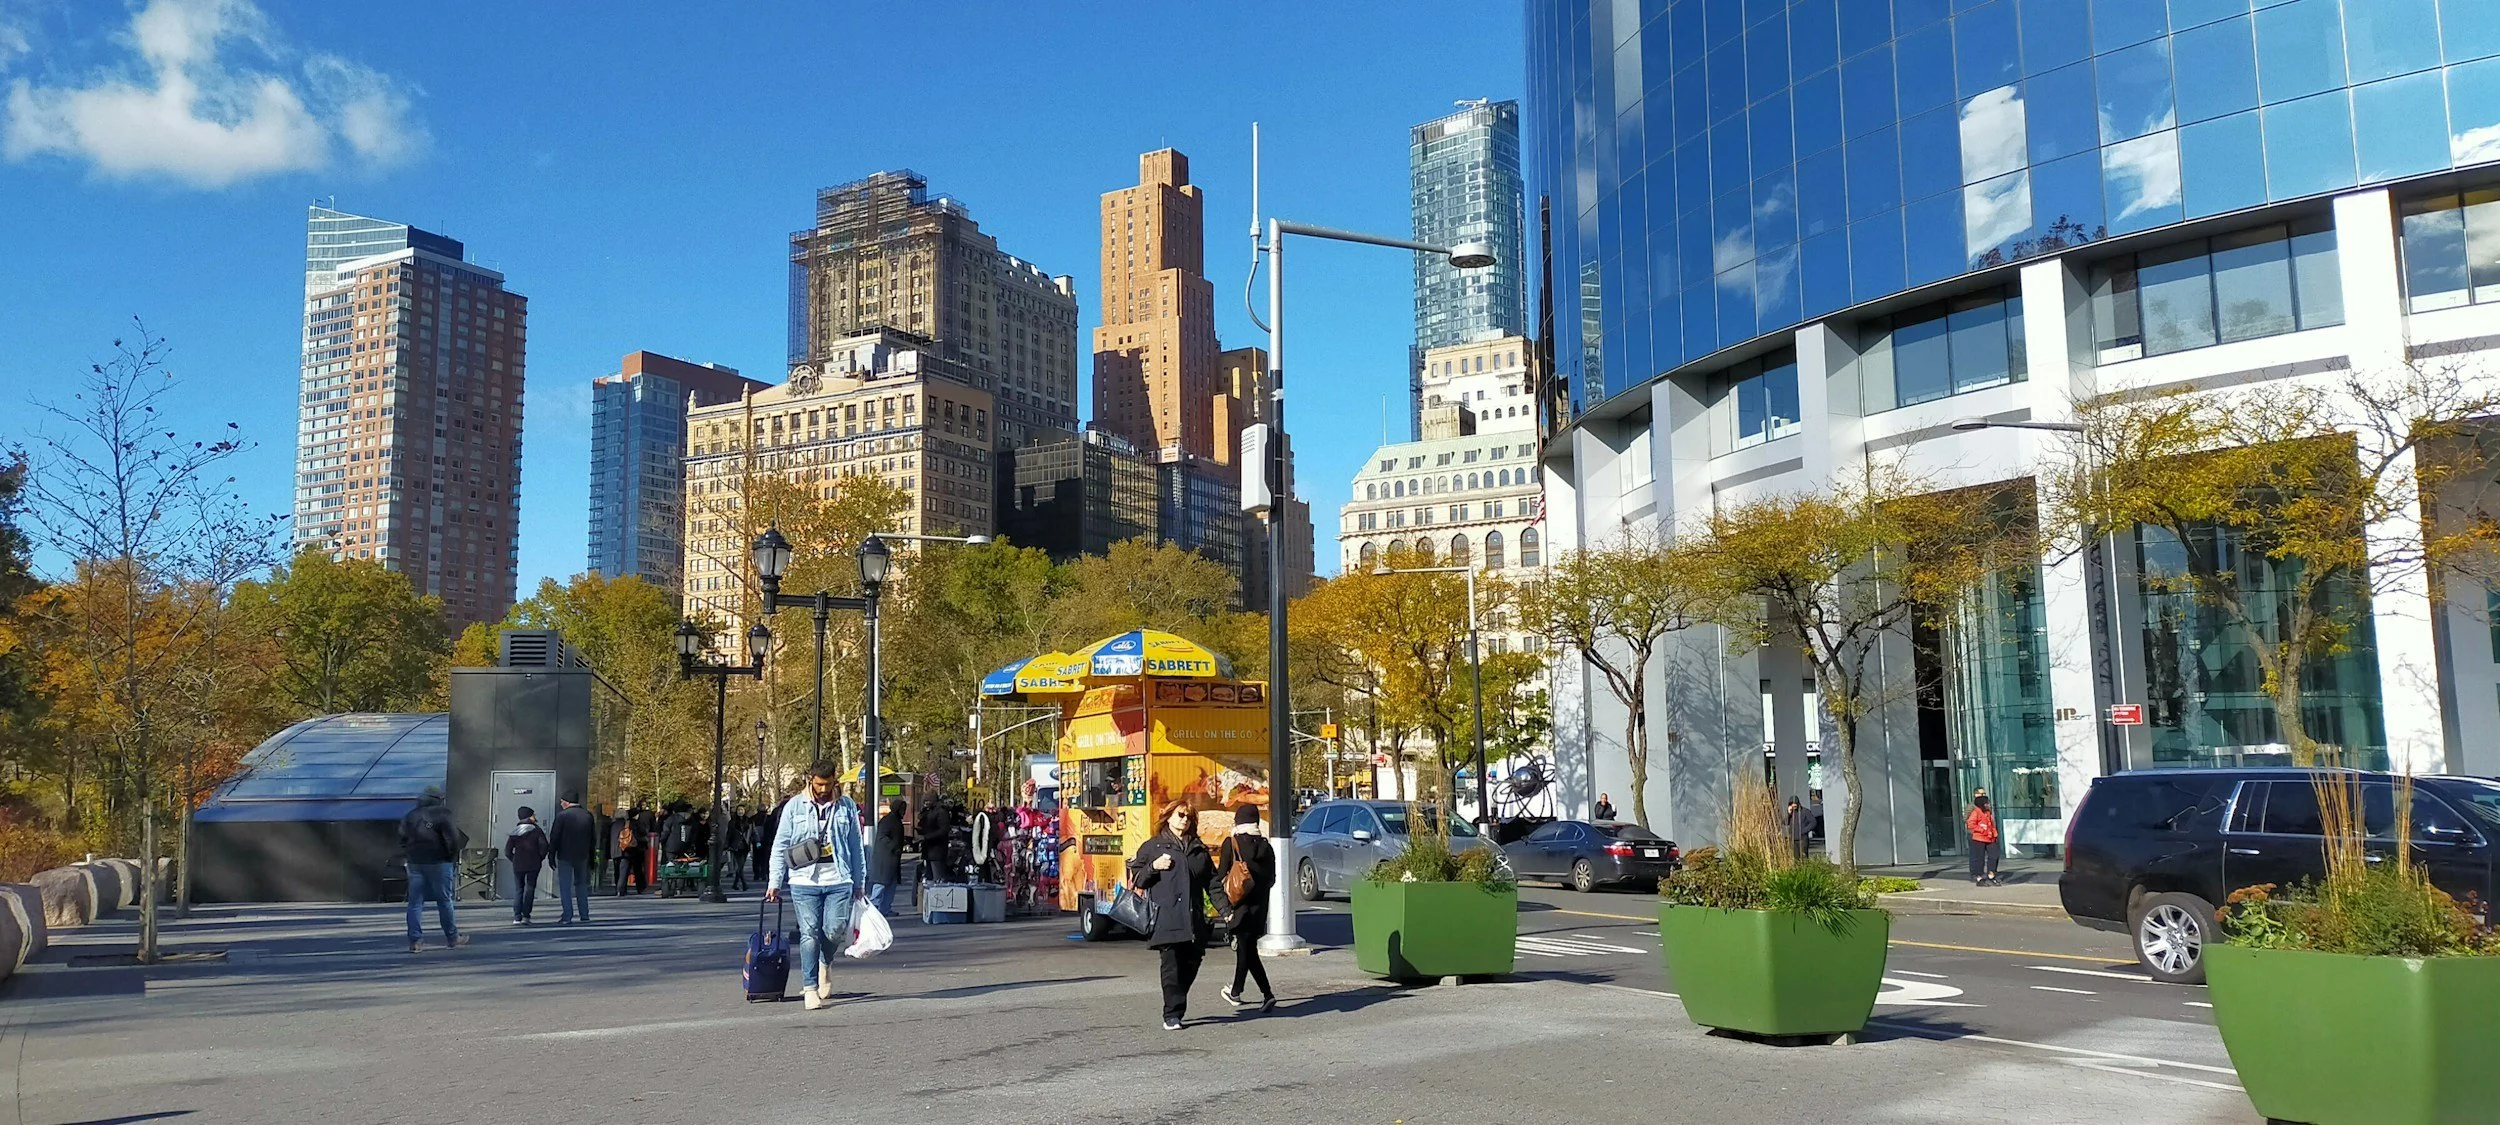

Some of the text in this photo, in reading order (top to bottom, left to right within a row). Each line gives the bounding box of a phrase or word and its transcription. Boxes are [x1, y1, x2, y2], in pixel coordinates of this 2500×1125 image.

[1148, 659, 1210, 672] SABRETT
[1173, 729, 1253, 739] GRILL ON THE GO
